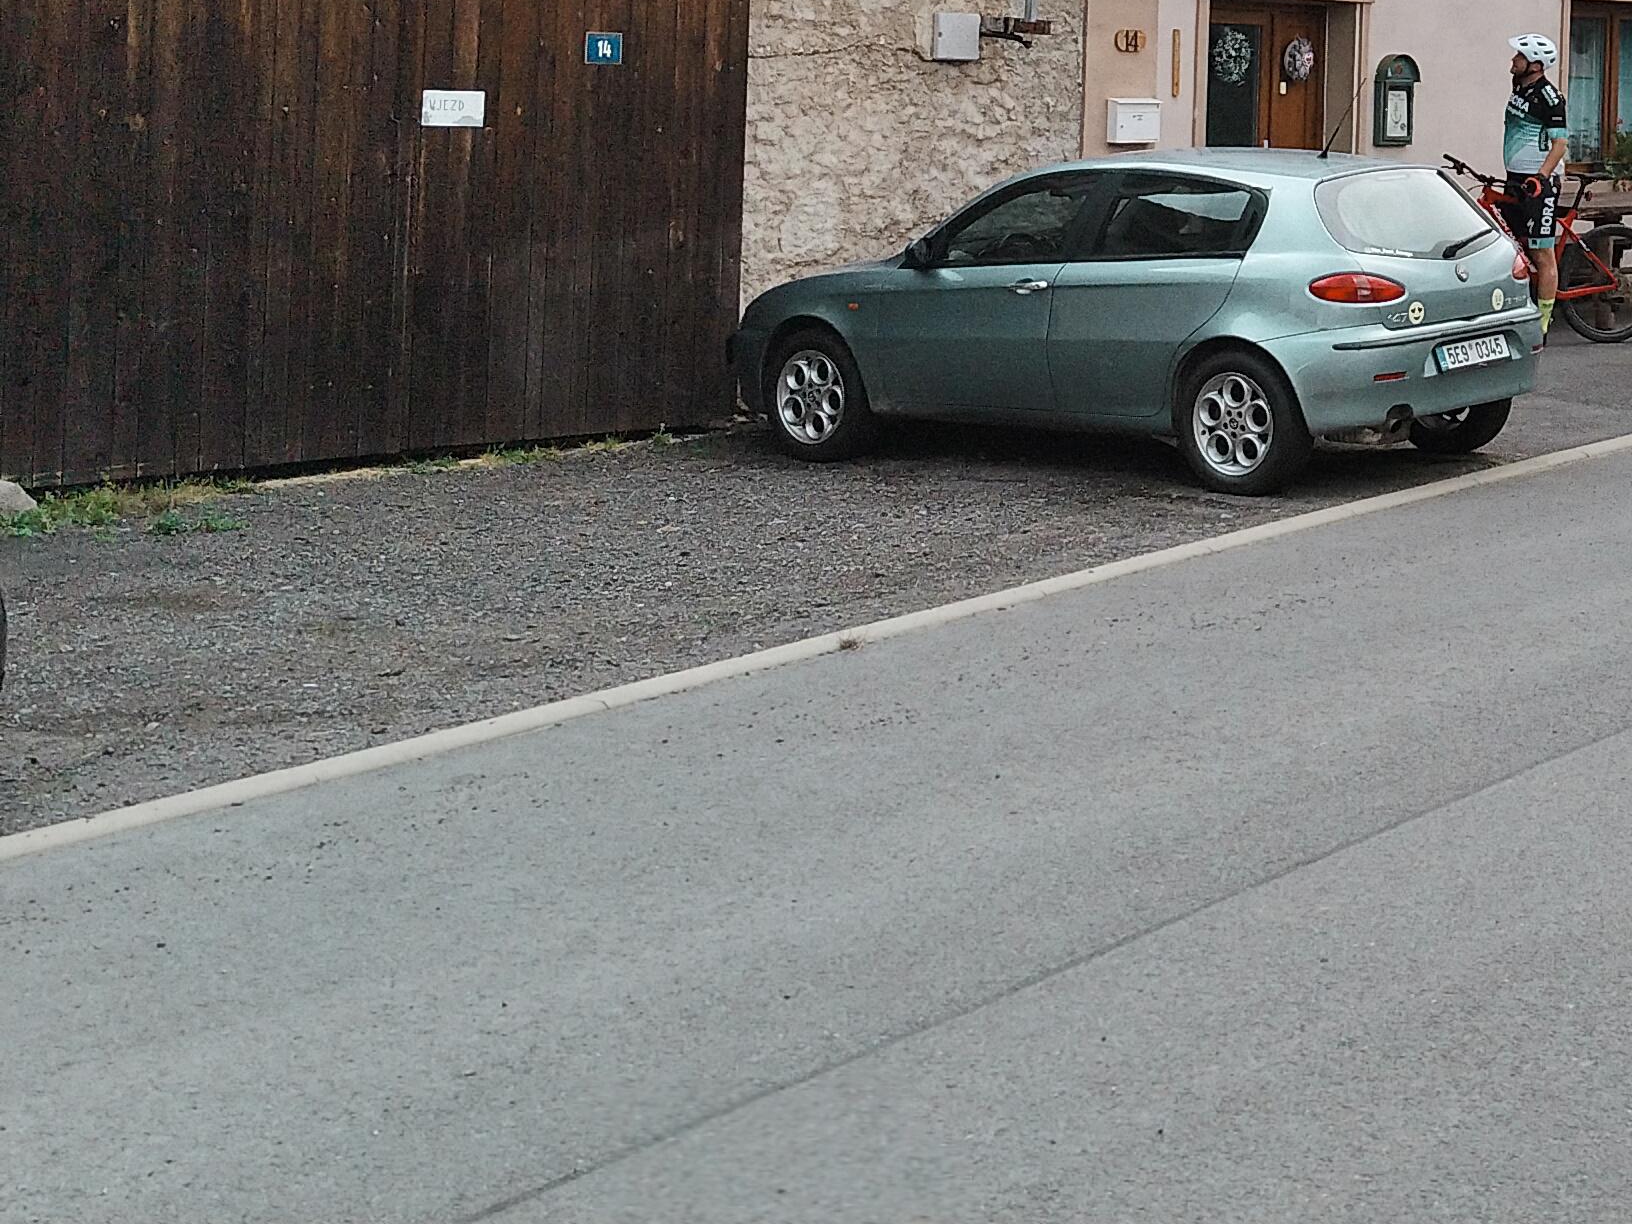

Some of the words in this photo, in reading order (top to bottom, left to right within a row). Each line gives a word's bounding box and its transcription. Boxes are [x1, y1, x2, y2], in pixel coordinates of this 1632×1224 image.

[597, 40, 612, 58] 14
[1123, 29, 1140, 53] 14
[1540, 196, 1556, 236] BORA
[1446, 344, 1470, 365] 5E9
[1475, 337, 1504, 359] 0345
